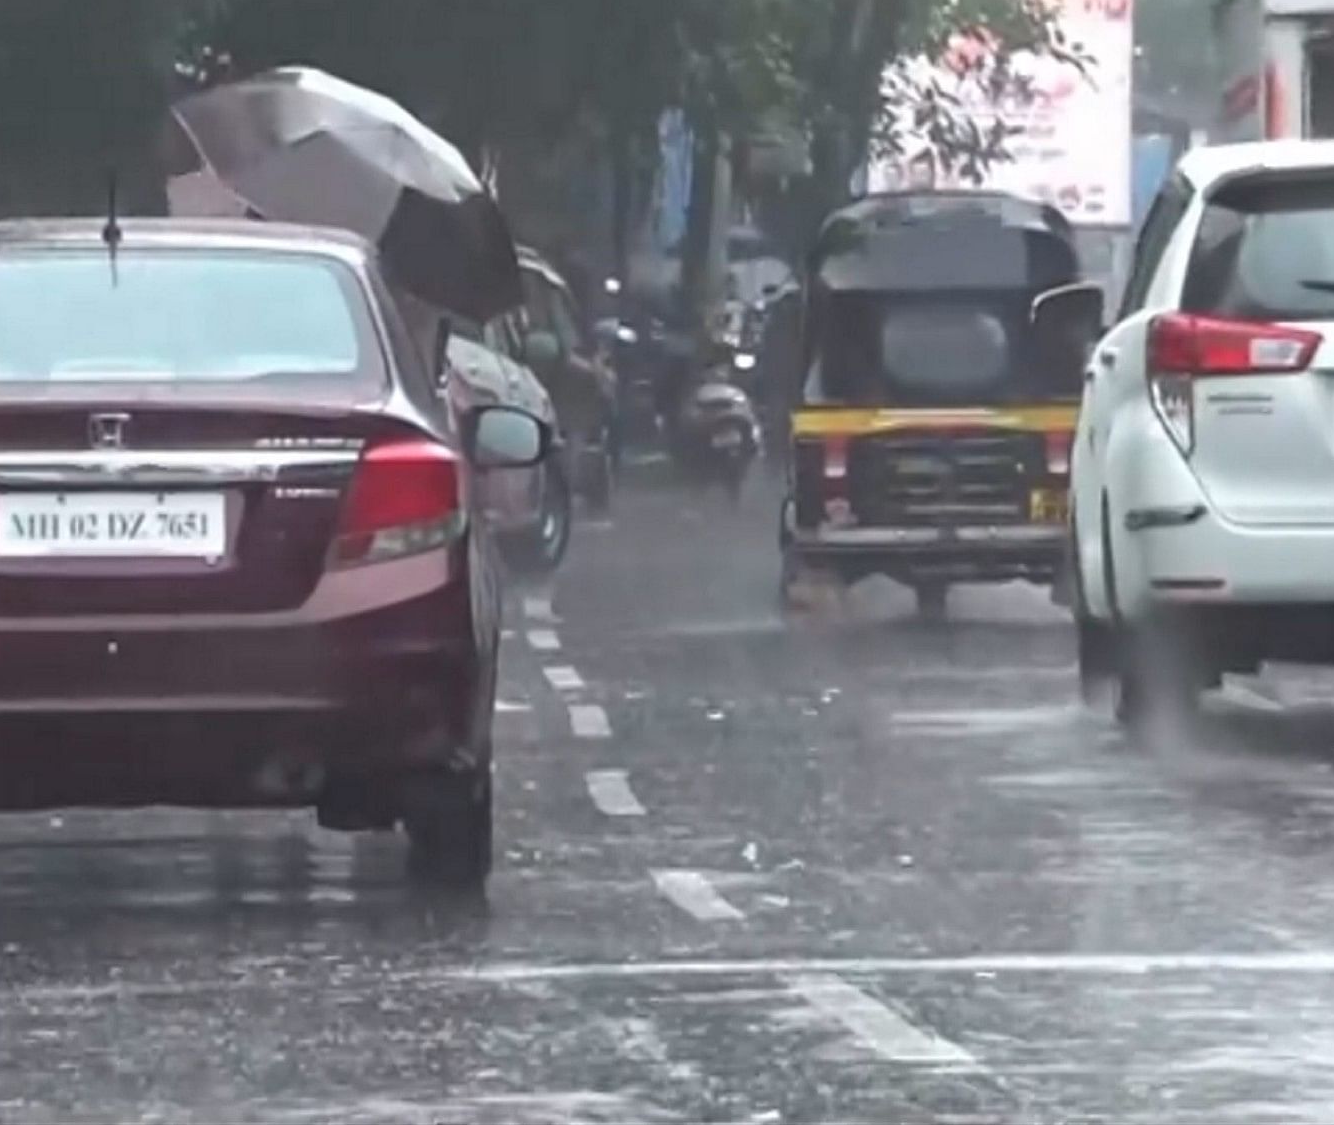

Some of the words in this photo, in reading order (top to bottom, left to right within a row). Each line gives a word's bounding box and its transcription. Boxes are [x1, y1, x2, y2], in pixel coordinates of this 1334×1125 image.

[8, 513, 60, 540] MH
[69, 513, 100, 540] 02
[108, 513, 148, 539] DZ
